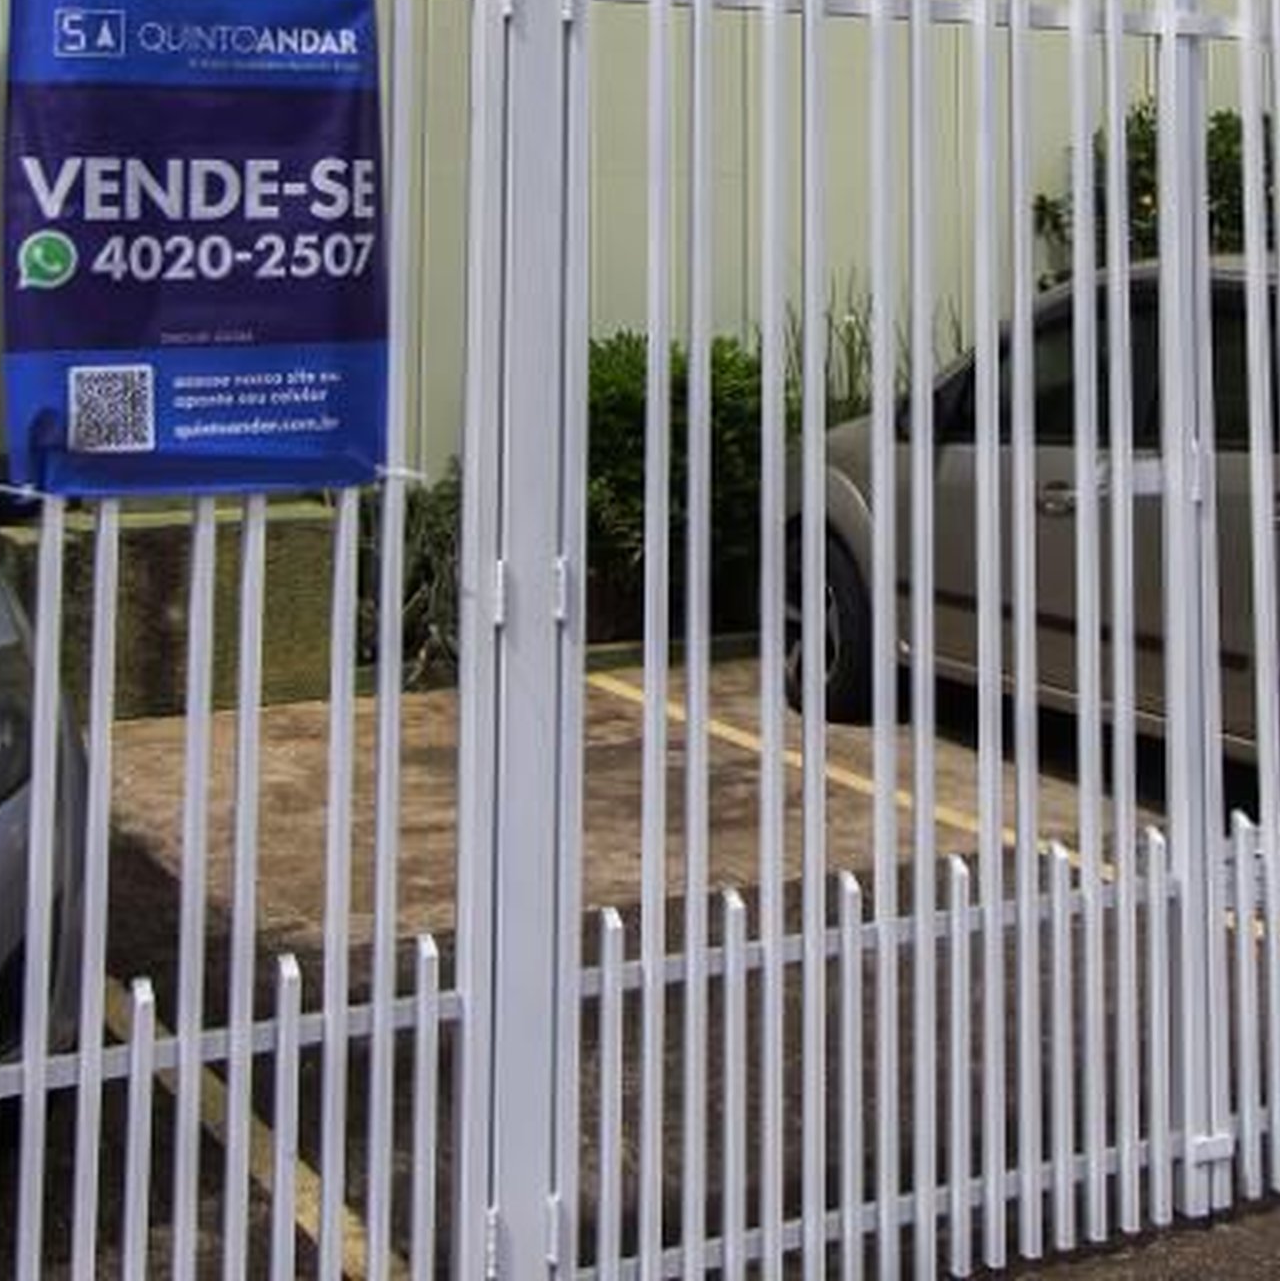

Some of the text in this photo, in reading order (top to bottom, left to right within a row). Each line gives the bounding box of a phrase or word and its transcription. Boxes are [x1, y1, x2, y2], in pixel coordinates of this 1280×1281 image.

[138, 22, 358, 54] QUINTOANDAR
[21, 157, 374, 220] VENDE-SE
[92, 233, 374, 281] 4020-2507
